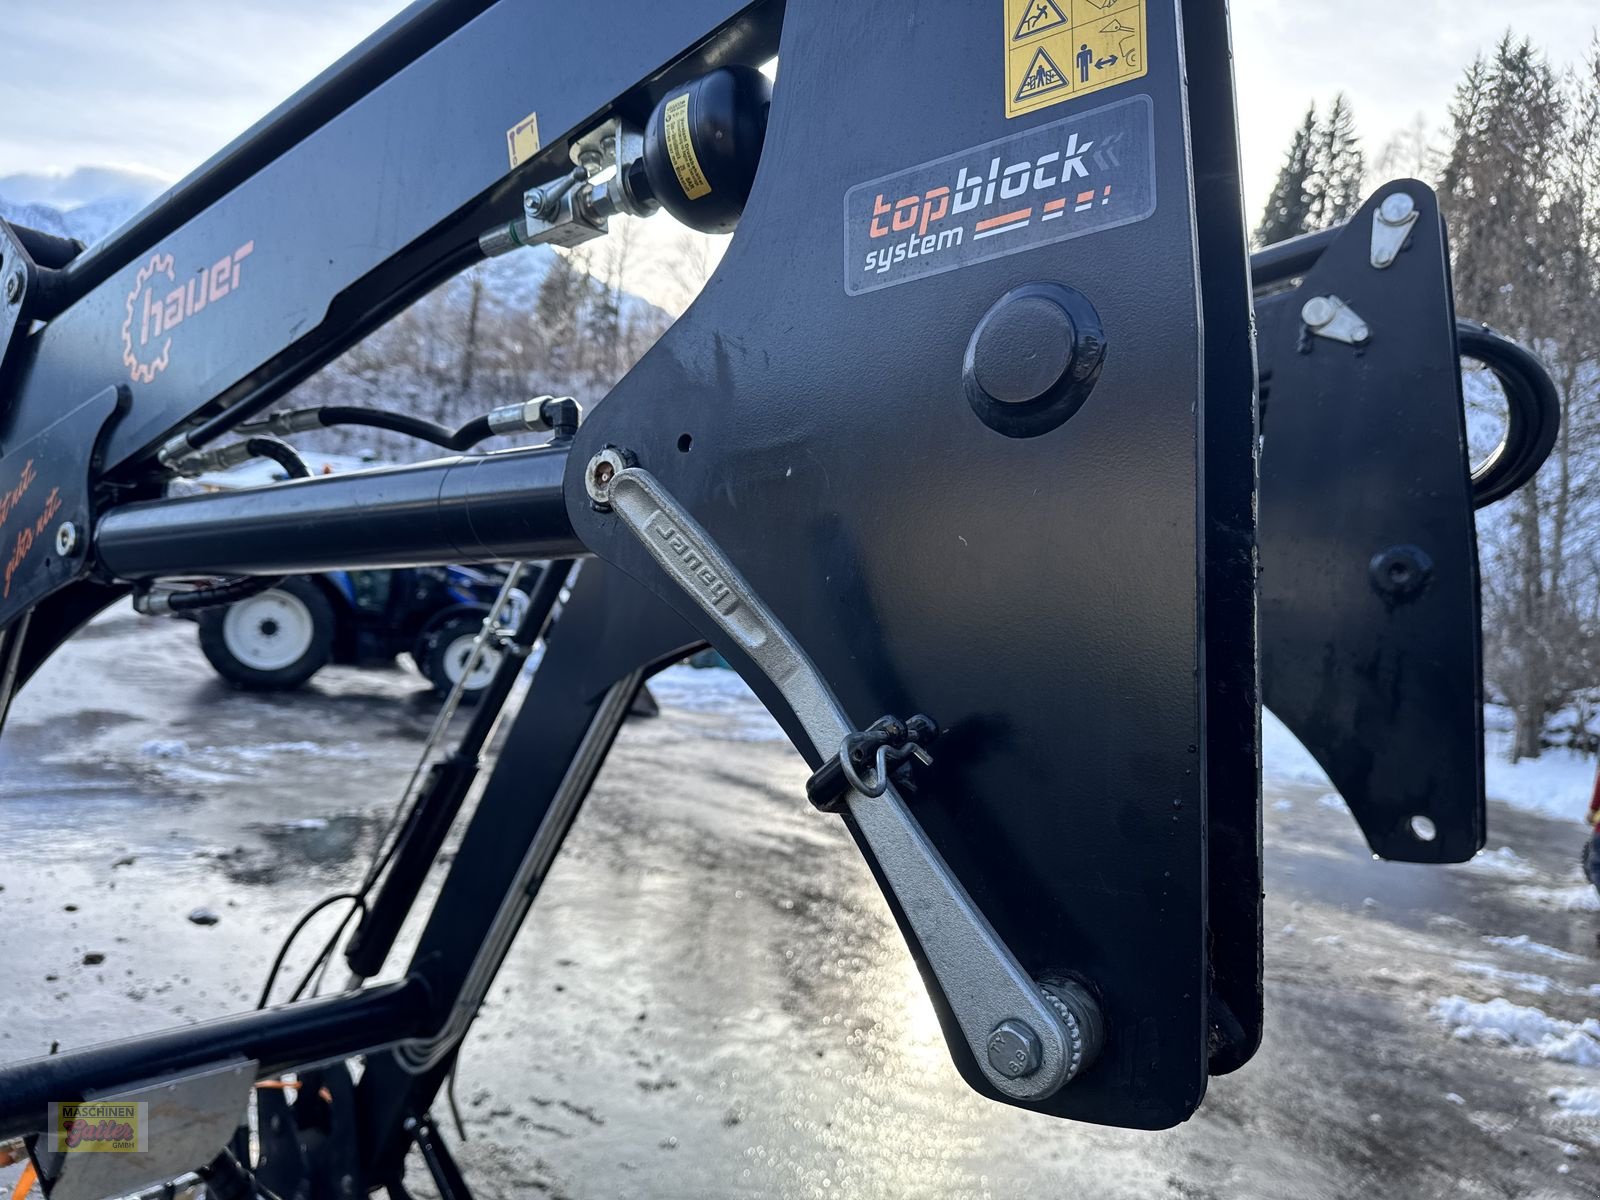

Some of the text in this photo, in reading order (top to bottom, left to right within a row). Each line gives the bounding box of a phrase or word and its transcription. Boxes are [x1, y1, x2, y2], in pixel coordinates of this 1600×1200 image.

[864, 226, 964, 274] system
[140, 239, 254, 346] hauer
[656, 526, 730, 606] hauer
